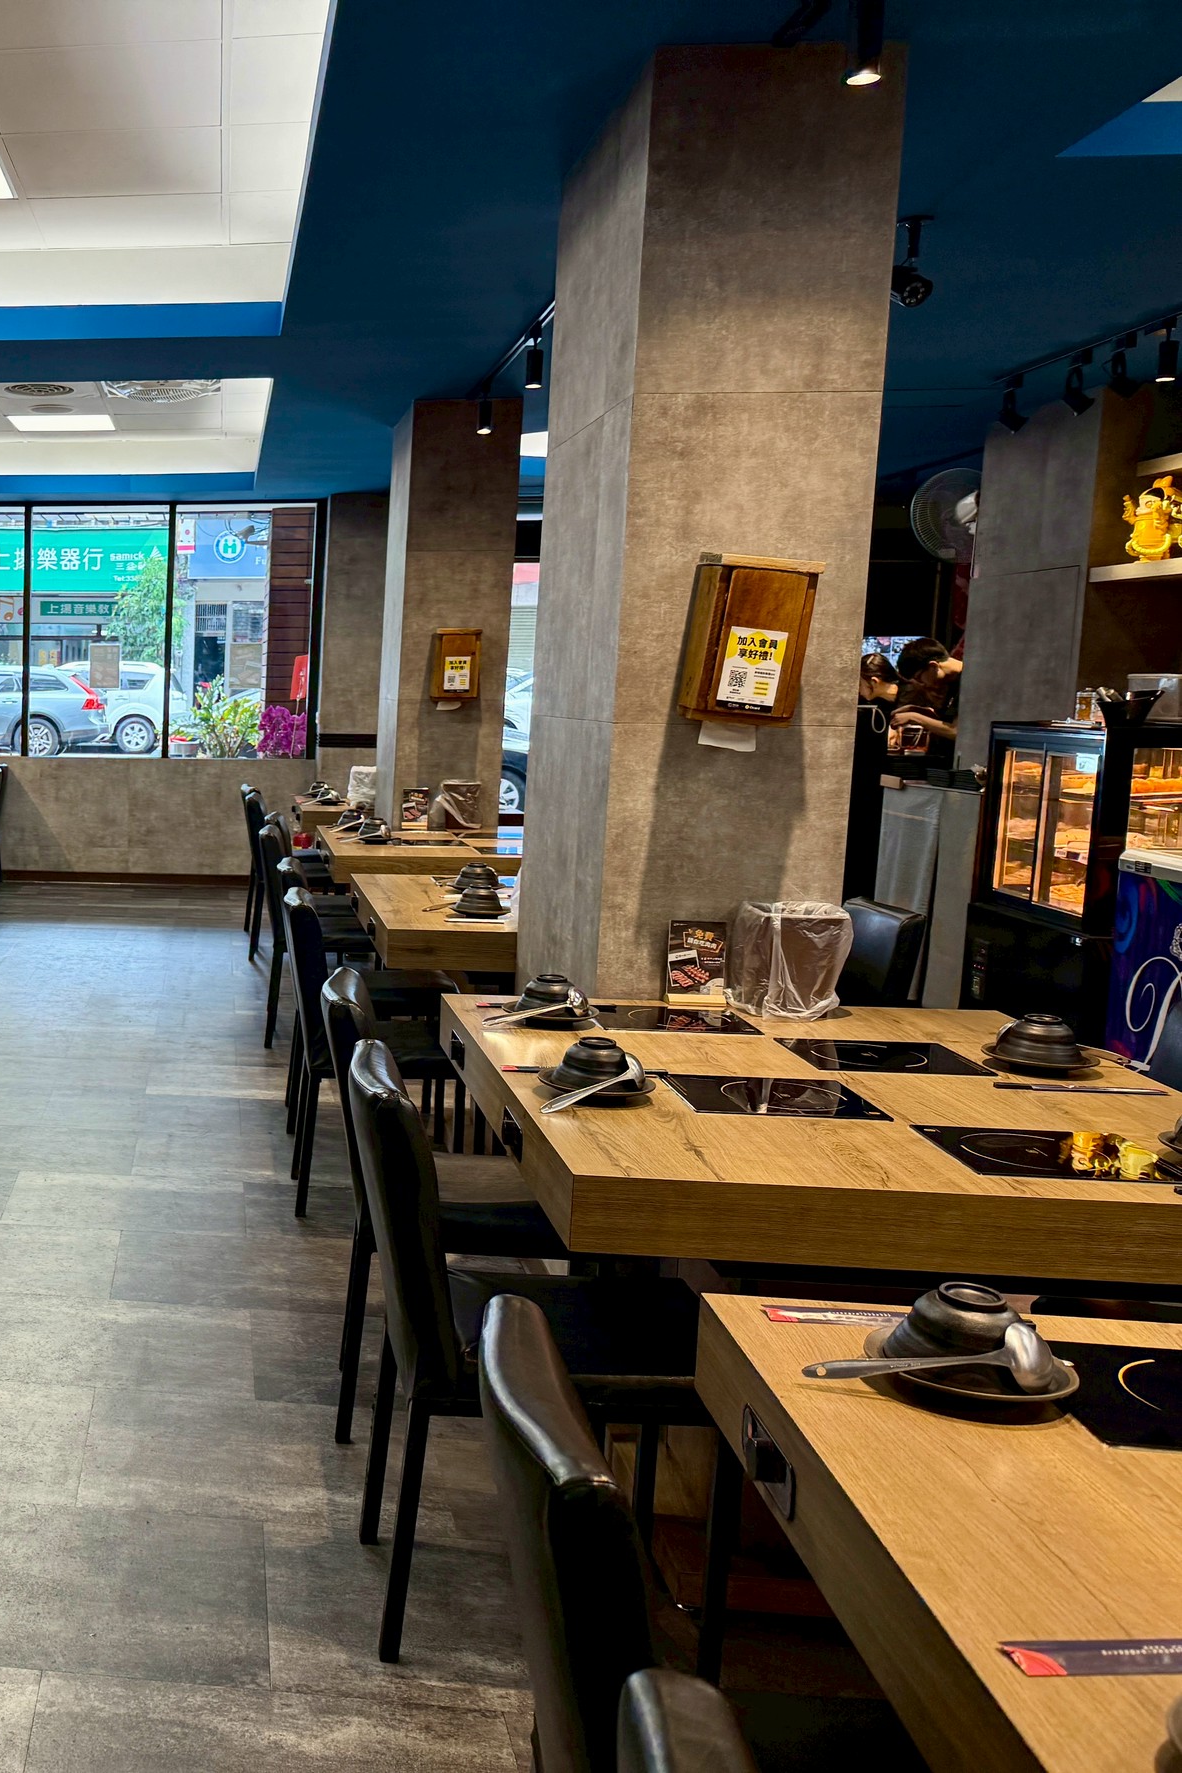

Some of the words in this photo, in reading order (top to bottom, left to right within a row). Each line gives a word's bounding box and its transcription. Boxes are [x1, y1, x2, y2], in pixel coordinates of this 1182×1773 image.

[737, 635, 778, 650] 加入會員
[737, 648, 773, 661] 享好禮!
